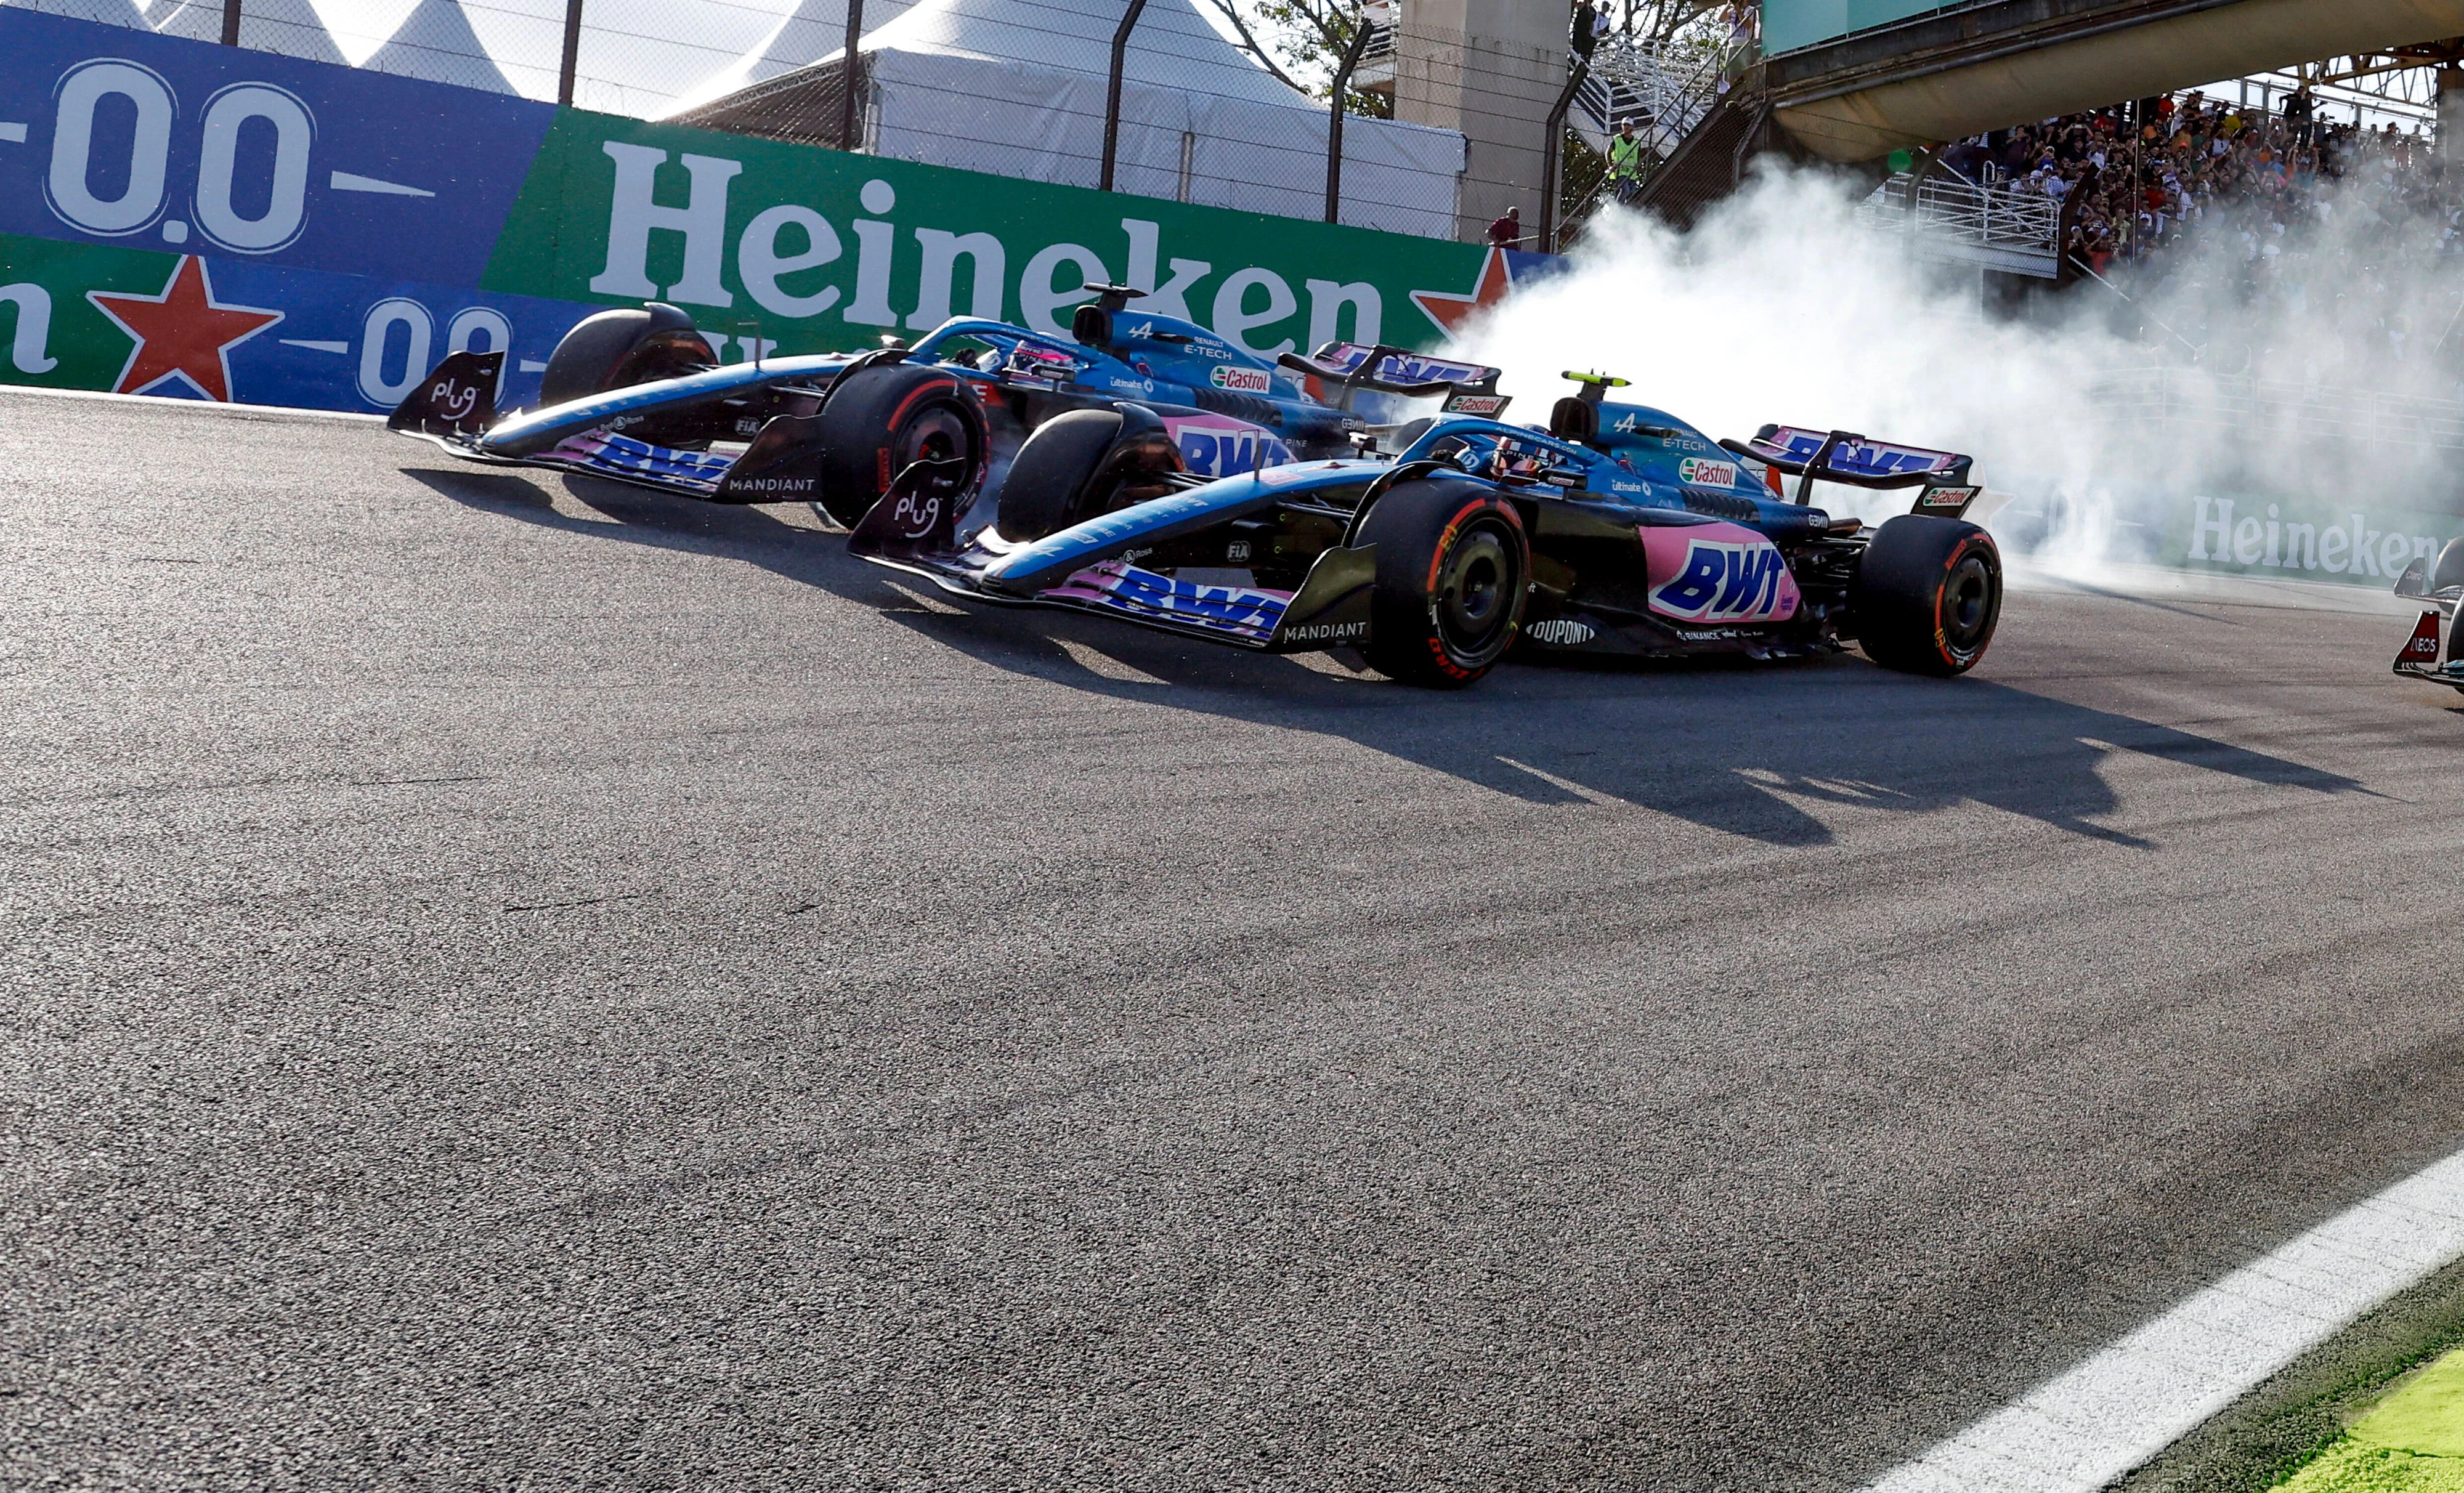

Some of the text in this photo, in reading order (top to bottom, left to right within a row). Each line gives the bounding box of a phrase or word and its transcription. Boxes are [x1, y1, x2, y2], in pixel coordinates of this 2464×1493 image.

[42, 57, 318, 255] 0.0
[590, 140, 1382, 362] Heineken
[1194, 336, 1224, 348] RENAULT
[355, 297, 514, 408] 00
[1184, 345, 1232, 360] E-TECH
[1110, 379, 1143, 389] ultimate
[1226, 370, 1267, 390] Castrol
[431, 378, 477, 421] plug
[1461, 397, 1499, 412] Castrol
[1286, 438, 1307, 447] PINE
[1496, 426, 1577, 455] ALPINECARS.COM
[1663, 438, 1706, 452] E-TECH
[1500, 448, 1534, 460] LPINE
[1695, 462, 1733, 485] Castrol
[729, 479, 815, 492] MANDIANT
[1613, 482, 1642, 492] ultimate
[1933, 490, 1969, 504] Castrol
[894, 490, 939, 538] plug
[2187, 495, 2439, 581] Heineken
[1228, 544, 1249, 559] FIA
[1651, 541, 1786, 618] BWT
[1109, 567, 1290, 638] BWT
[1284, 622, 1366, 641] MANDIANT
[1533, 620, 1588, 644] DUPONT
[1685, 631, 1721, 641] BINANCE
